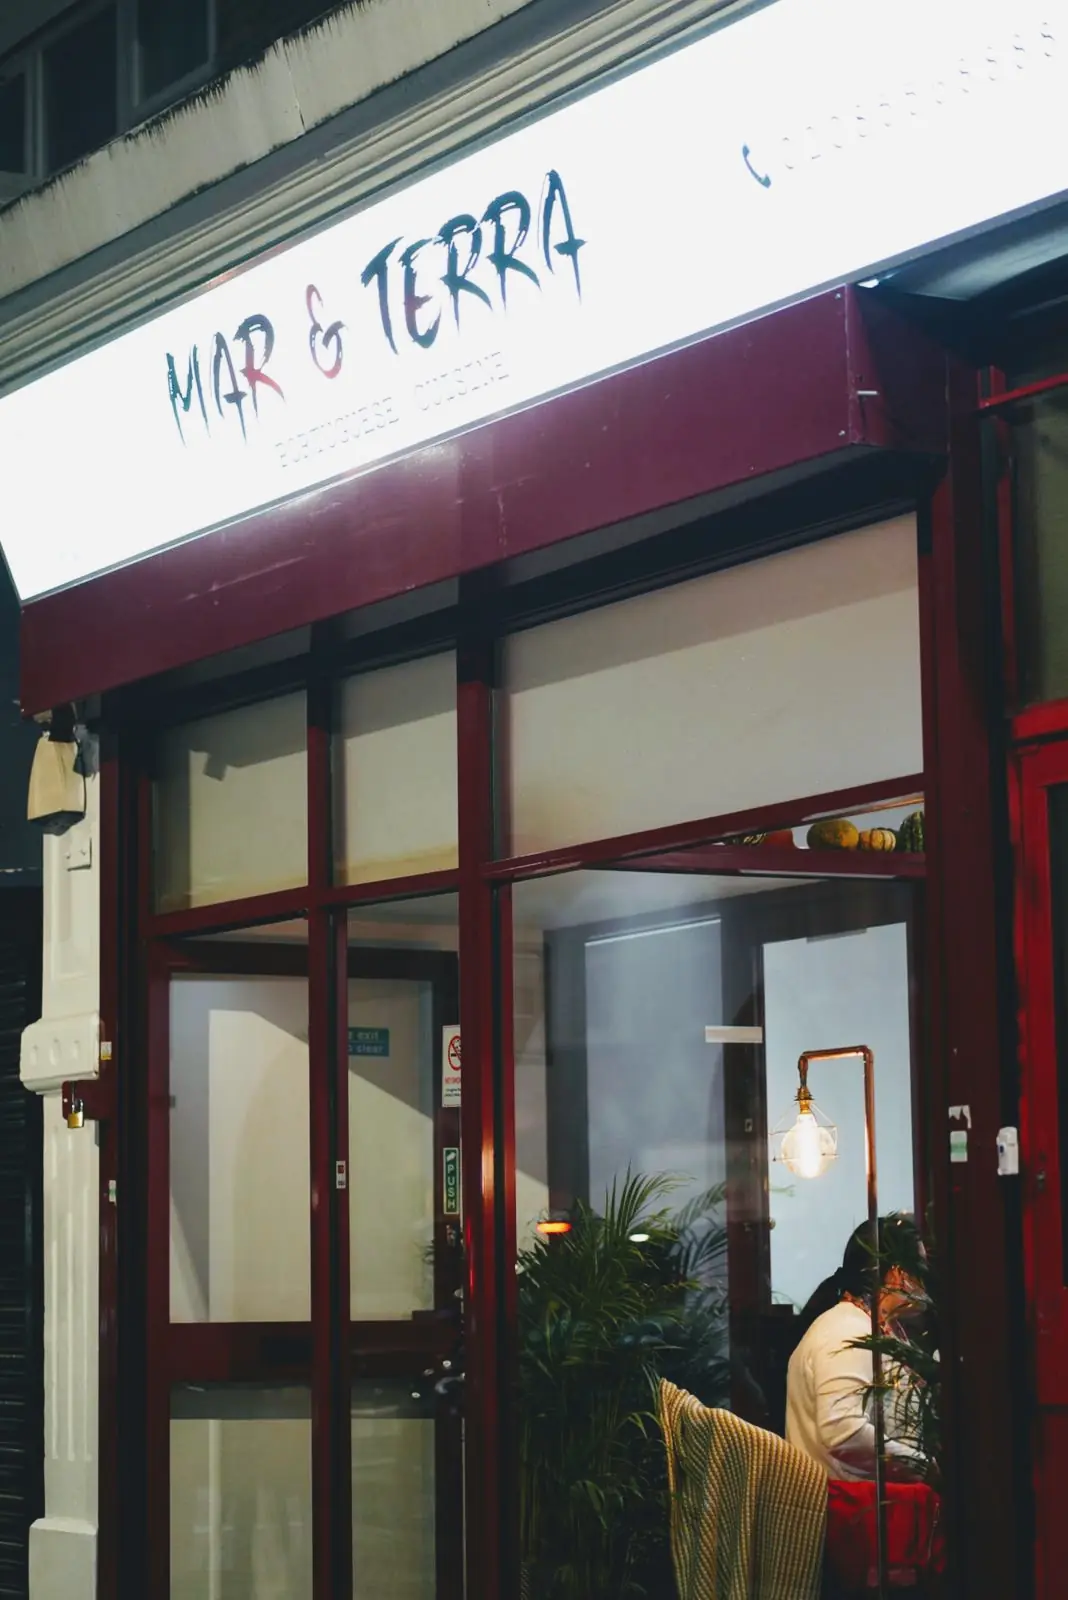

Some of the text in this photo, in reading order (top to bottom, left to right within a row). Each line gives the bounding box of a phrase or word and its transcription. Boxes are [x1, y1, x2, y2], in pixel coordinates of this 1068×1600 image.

[166, 169, 587, 447] MAR & TERRA
[446, 1165, 456, 1209] PUSH
